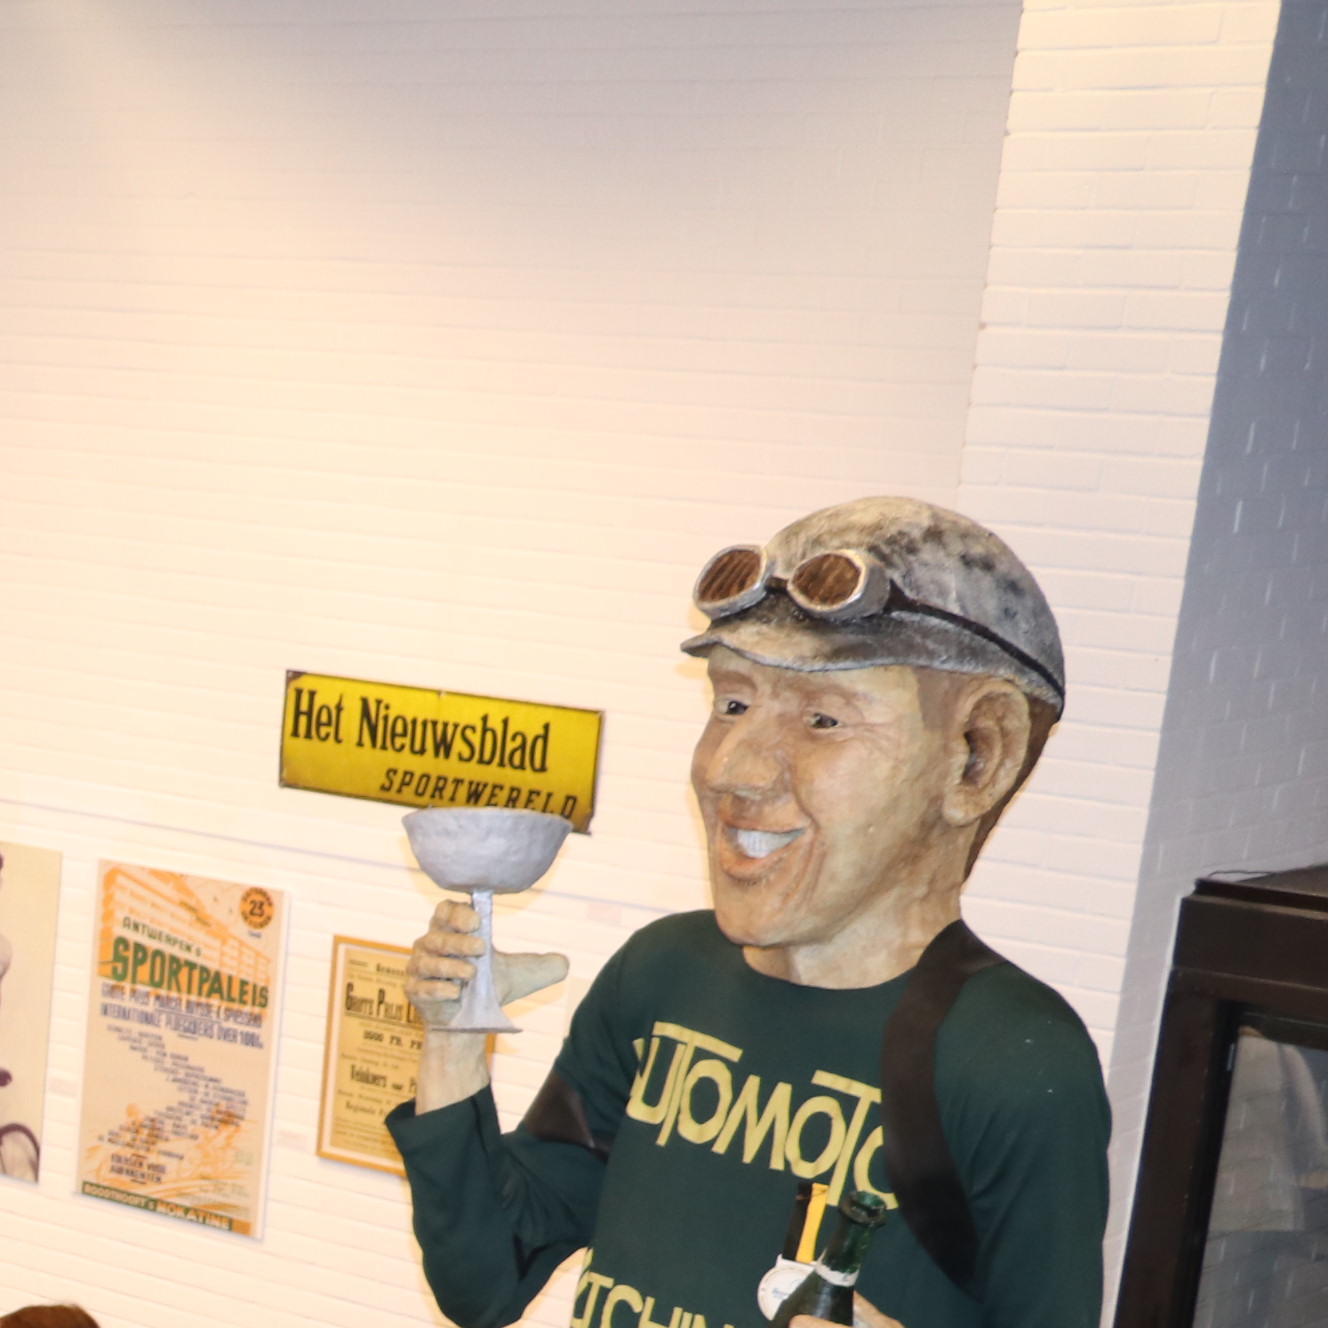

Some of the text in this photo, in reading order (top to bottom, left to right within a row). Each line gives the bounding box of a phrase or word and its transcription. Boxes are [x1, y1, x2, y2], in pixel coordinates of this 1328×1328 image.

[290, 687, 551, 773] Het Nieuwsblad
[380, 767, 579, 820] SPORTWERELD
[111, 936, 269, 1010] SPORTPALEIS
